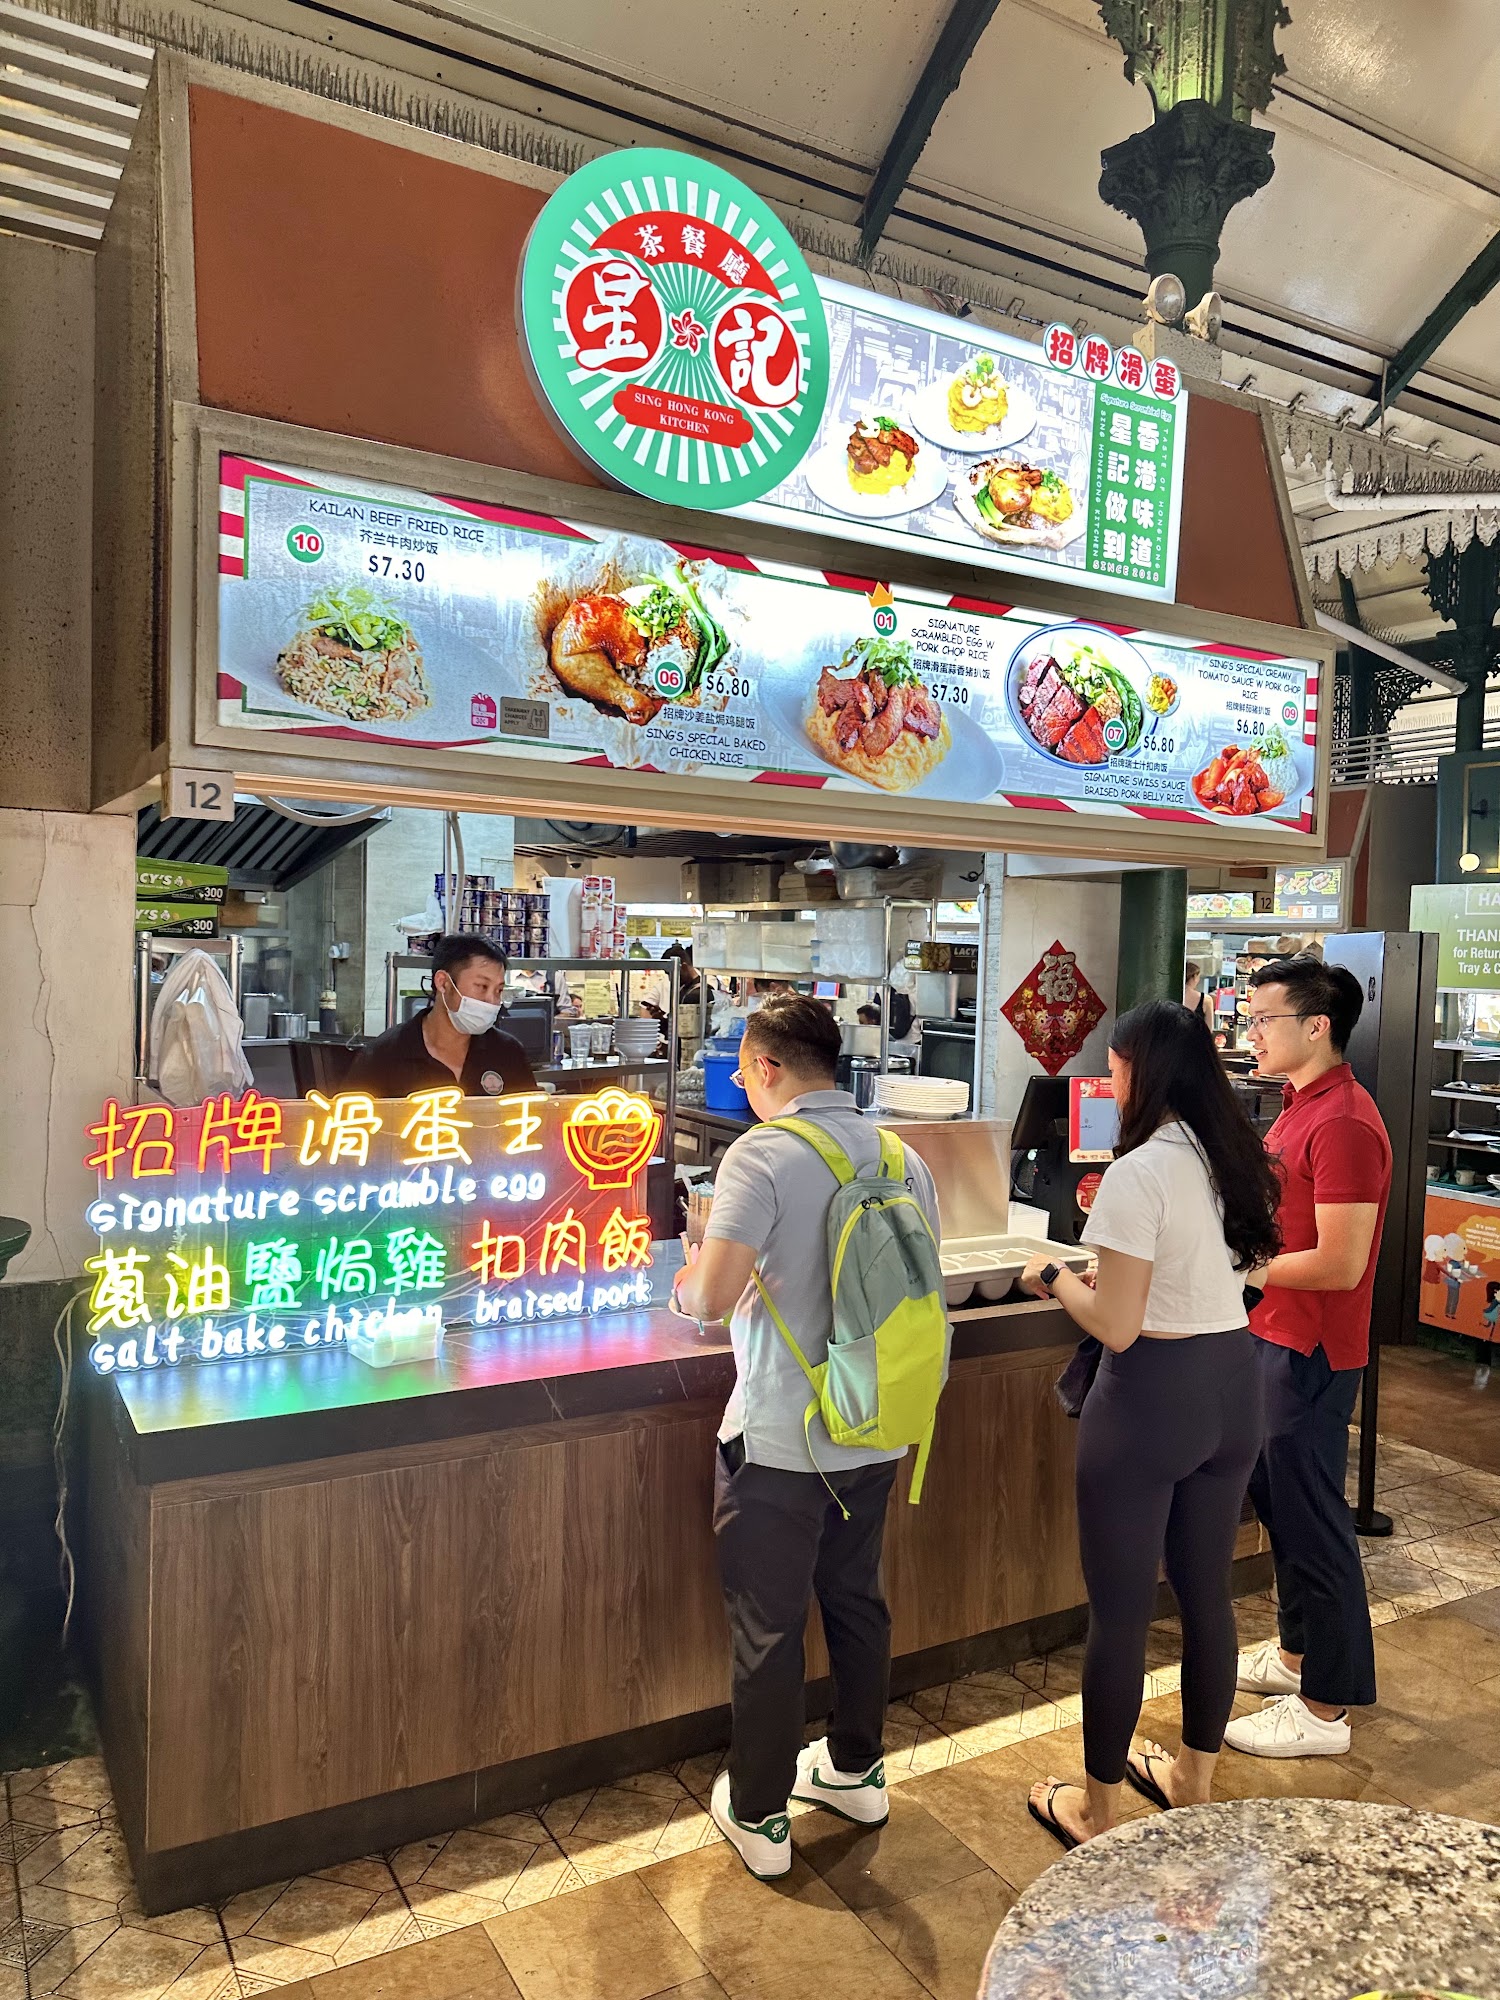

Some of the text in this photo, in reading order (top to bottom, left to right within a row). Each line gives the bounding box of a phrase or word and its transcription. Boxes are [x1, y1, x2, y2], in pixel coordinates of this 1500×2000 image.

[634, 224, 751, 285] 茶餐廳
[575, 259, 799, 407] 星記
[1050, 329, 1176, 397] 招牌滑蛋
[634, 392, 734, 425] SING HONG KONG
[1100, 393, 1172, 423] Signature Scrambled Egg
[659, 413, 710, 434] KITCHEN
[1094, 443, 1104, 504] HONGKONG
[1103, 412, 1132, 563] 星記做到
[1130, 420, 1160, 568] 香港味道
[1155, 428, 1169, 569] TASTE OF HONGKONG
[309, 499, 485, 543] KAILAN BEEF FRIED RICE
[293, 533, 321, 552] 10
[359, 529, 439, 555] 芥兰牛肉炒饭
[1093, 509, 1101, 557] KITCHEN
[369, 554, 425, 583] $7.30
[1093, 560, 1159, 582] SINCE 2018
[877, 613, 892, 628] 01
[928, 618, 980, 635] SIGNATURE
[911, 628, 995, 649] SCRAMBLED EGG W
[916, 641, 988, 661] PORK CHOP RICE
[659, 670, 679, 686] 06
[1209, 659, 1292, 680] SING'S SPECIAL CREAMY
[705, 677, 750, 698] $6.80
[1198, 670, 1301, 694] TOMATO SAUCE W PORK CHOP
[931, 684, 968, 704] $7.30
[1242, 690, 1258, 700] RICE
[1284, 707, 1297, 719] 09
[1108, 728, 1121, 740] 07
[1236, 719, 1265, 736] $6.80
[646, 727, 766, 752] SING'S SPECIAL BAKED
[1143, 736, 1174, 753] $6.80
[669, 746, 744, 765] CHICKEN RICE
[1083, 773, 1186, 791] SIGNATURE SWISS SAUCE
[185, 781, 221, 810] 12
[1084, 786, 1184, 804] BRAISED PORK BELLY RICE
[204, 887, 223, 899] 300
[1260, 897, 1271, 910] 12
[193, 919, 213, 931] 300
[1453, 946, 1468, 958] for
[1038, 953, 1078, 1005] 福
[1458, 962, 1480, 976] Tray
[1482, 963, 1491, 974] &
[88, 1088, 549, 1179] 招牌滑蛋王
[89, 1186, 300, 1233] signature
[314, 1165, 477, 1215] scramble
[490, 1171, 546, 1202] egg
[470, 1206, 653, 1285] 扣肉飯
[91, 1325, 185, 1372] salt
[201, 1313, 286, 1359] bake
[475, 1280, 584, 1324] braised
[592, 1272, 651, 1313] pork
